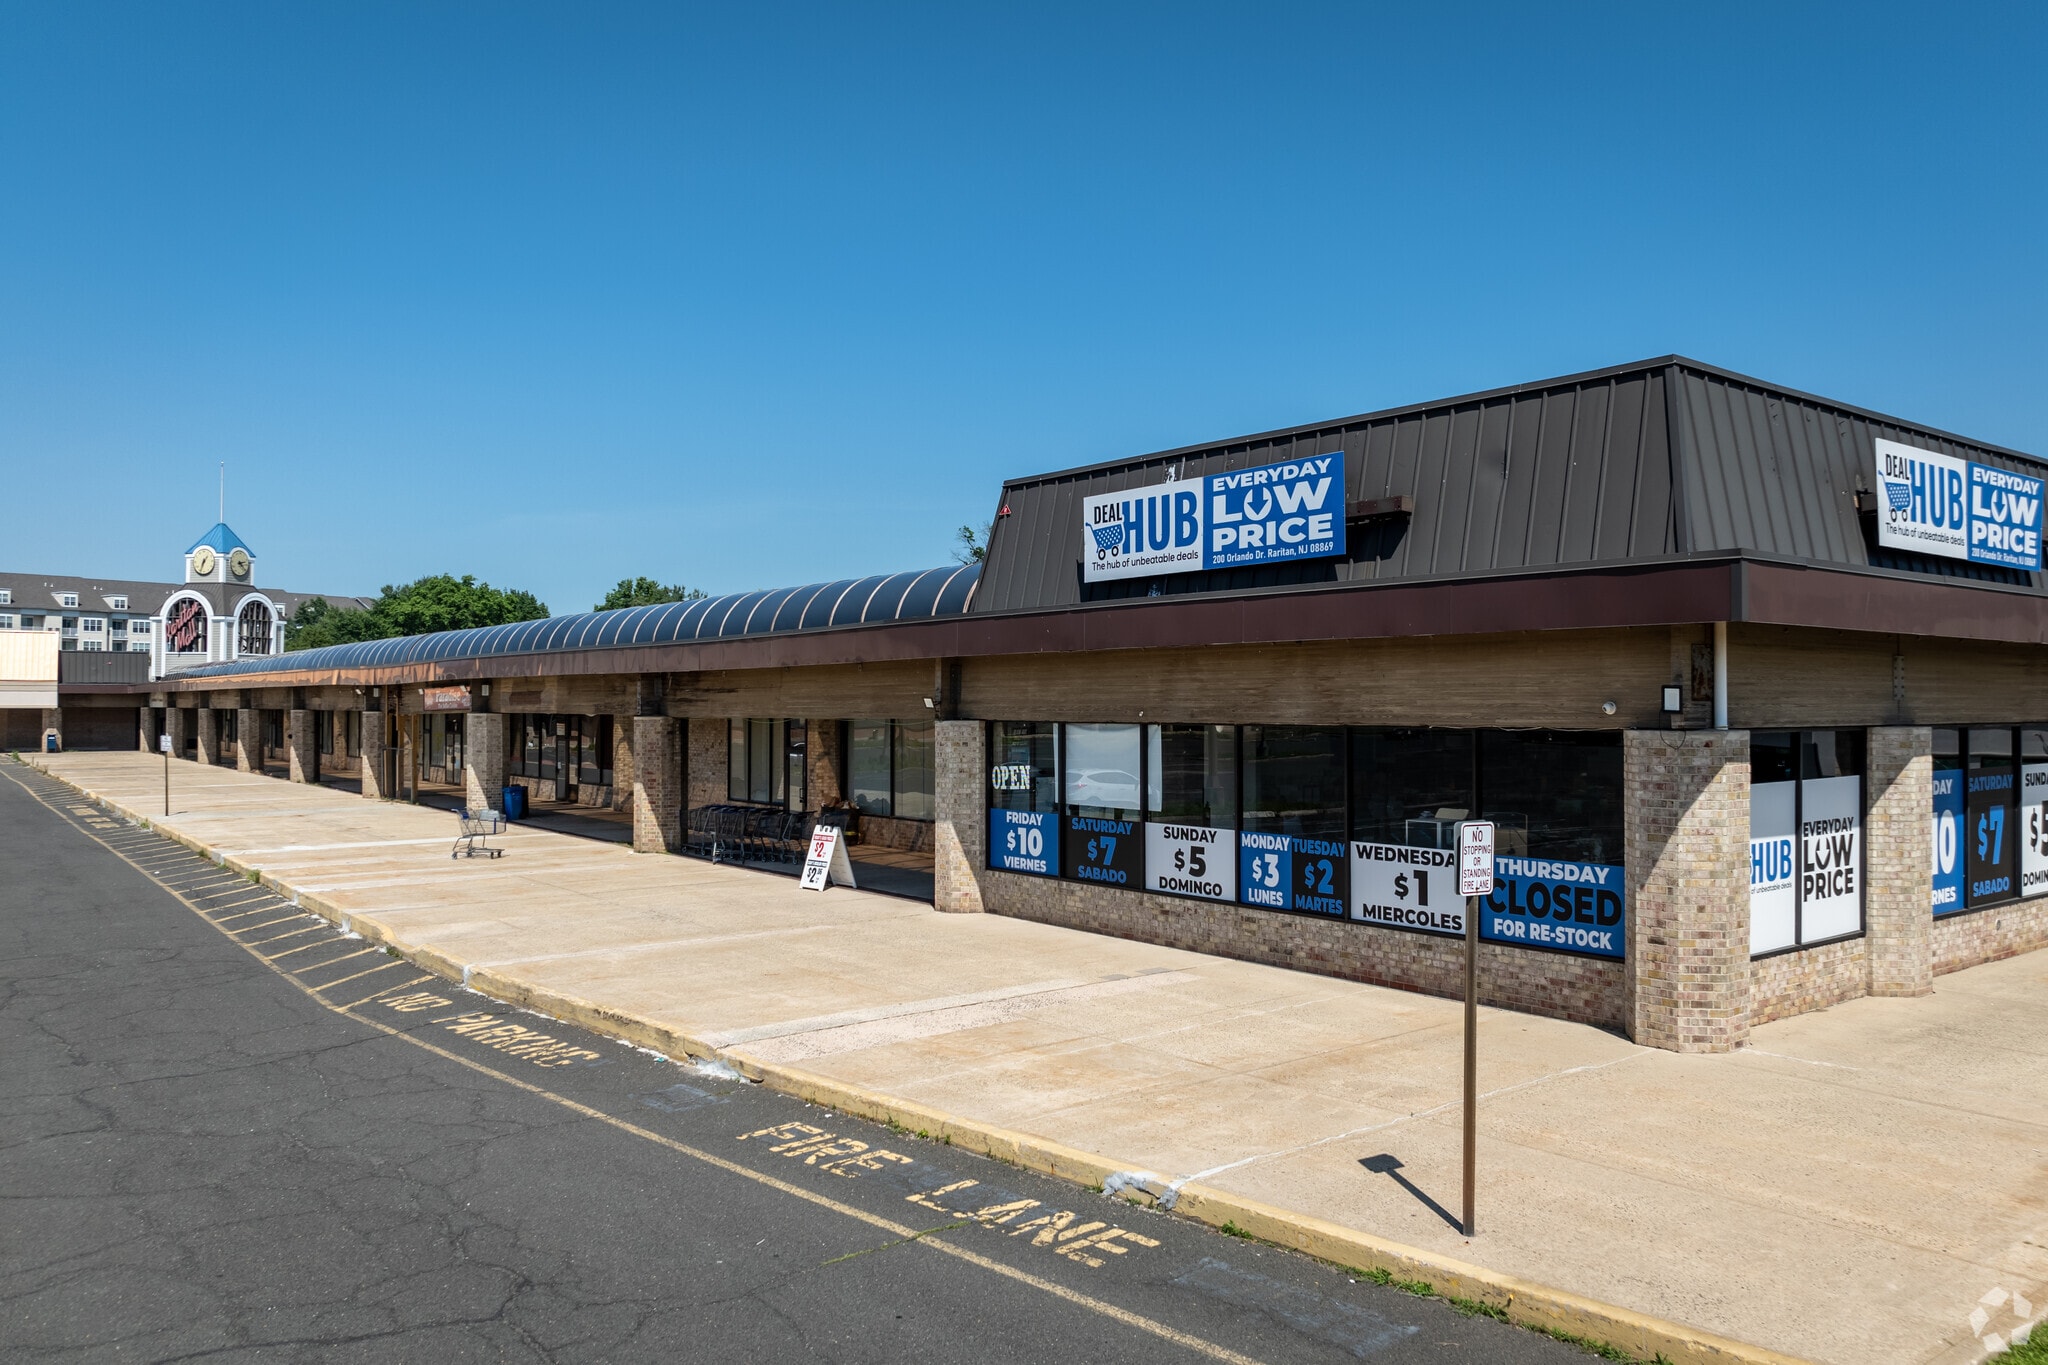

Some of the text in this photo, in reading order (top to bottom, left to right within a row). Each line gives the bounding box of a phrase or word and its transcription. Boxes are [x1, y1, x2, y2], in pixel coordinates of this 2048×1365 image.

[1213, 458, 1332, 492] EVERYDAY
[1886, 454, 1910, 480] DEAL
[1973, 466, 2039, 495] EVERYDAY
[1213, 477, 1332, 524] LOW
[1909, 460, 1963, 530] HUB
[1972, 485, 2038, 526] LOW
[1094, 502, 1122, 525] DEAL
[1122, 491, 1198, 554] HUB
[1213, 513, 1333, 552] PRICE
[1886, 522, 1897, 534] The
[1898, 524, 1909, 536] hub
[1911, 528, 1916, 537] of
[1972, 520, 2037, 556] PRICE
[1092, 550, 1198, 571] The hub of unbeatable deals
[1212, 542, 1334, 564] 200 Orlando Dr. Raritan, NJ 08869
[992, 765, 1030, 790] OPEN
[1934, 779, 1952, 795] DAY
[1969, 774, 2013, 792] SATURDAY
[1006, 811, 1043, 826] FRIDAY
[1072, 818, 1133, 835] SATURDAY
[1804, 817, 1854, 838] EVERYDAY
[1007, 827, 1042, 857] $10
[1163, 826, 1218, 844] SUNDAY
[1242, 833, 1290, 851] MONDAY
[1472, 830, 1483, 842] NO
[1932, 810, 1956, 874] 10
[1978, 805, 2004, 864] $7
[1087, 836, 1116, 866] $7
[1292, 837, 1346, 858] TUESDAY
[1356, 844, 1454, 868] WEDNESDA
[1464, 845, 1491, 855] STOPPING
[1804, 834, 1853, 872] LOW
[1004, 855, 1046, 872] VIERNES
[1174, 846, 1206, 877] $5
[1252, 854, 1279, 888] $3
[1464, 868, 1490, 878] STANDING
[1474, 857, 1481, 866] OR
[1496, 858, 1610, 884] THURSDAY
[1752, 840, 1792, 884] HUB
[1078, 865, 1126, 884] SABADO
[1159, 876, 1222, 896] DOMINGO
[1304, 859, 1334, 895] $2
[1464, 880, 1488, 890] FIRE LANE
[1804, 868, 1853, 902] PRICE
[1973, 876, 2010, 897] SABADO
[2023, 870, 2048, 886] DOMIN
[1249, 888, 1283, 906] LUNES
[1394, 870, 1428, 906] $1
[1932, 886, 1956, 905] RNES
[1296, 894, 1343, 916] MARTES
[1486, 878, 1622, 926] CLOSED
[1362, 904, 1462, 930] MIERCOLES
[1494, 918, 1612, 950] FOR RE-STOCK
[377, 992, 453, 1012] NO
[736, 1121, 1162, 1268] FIRE LANE
